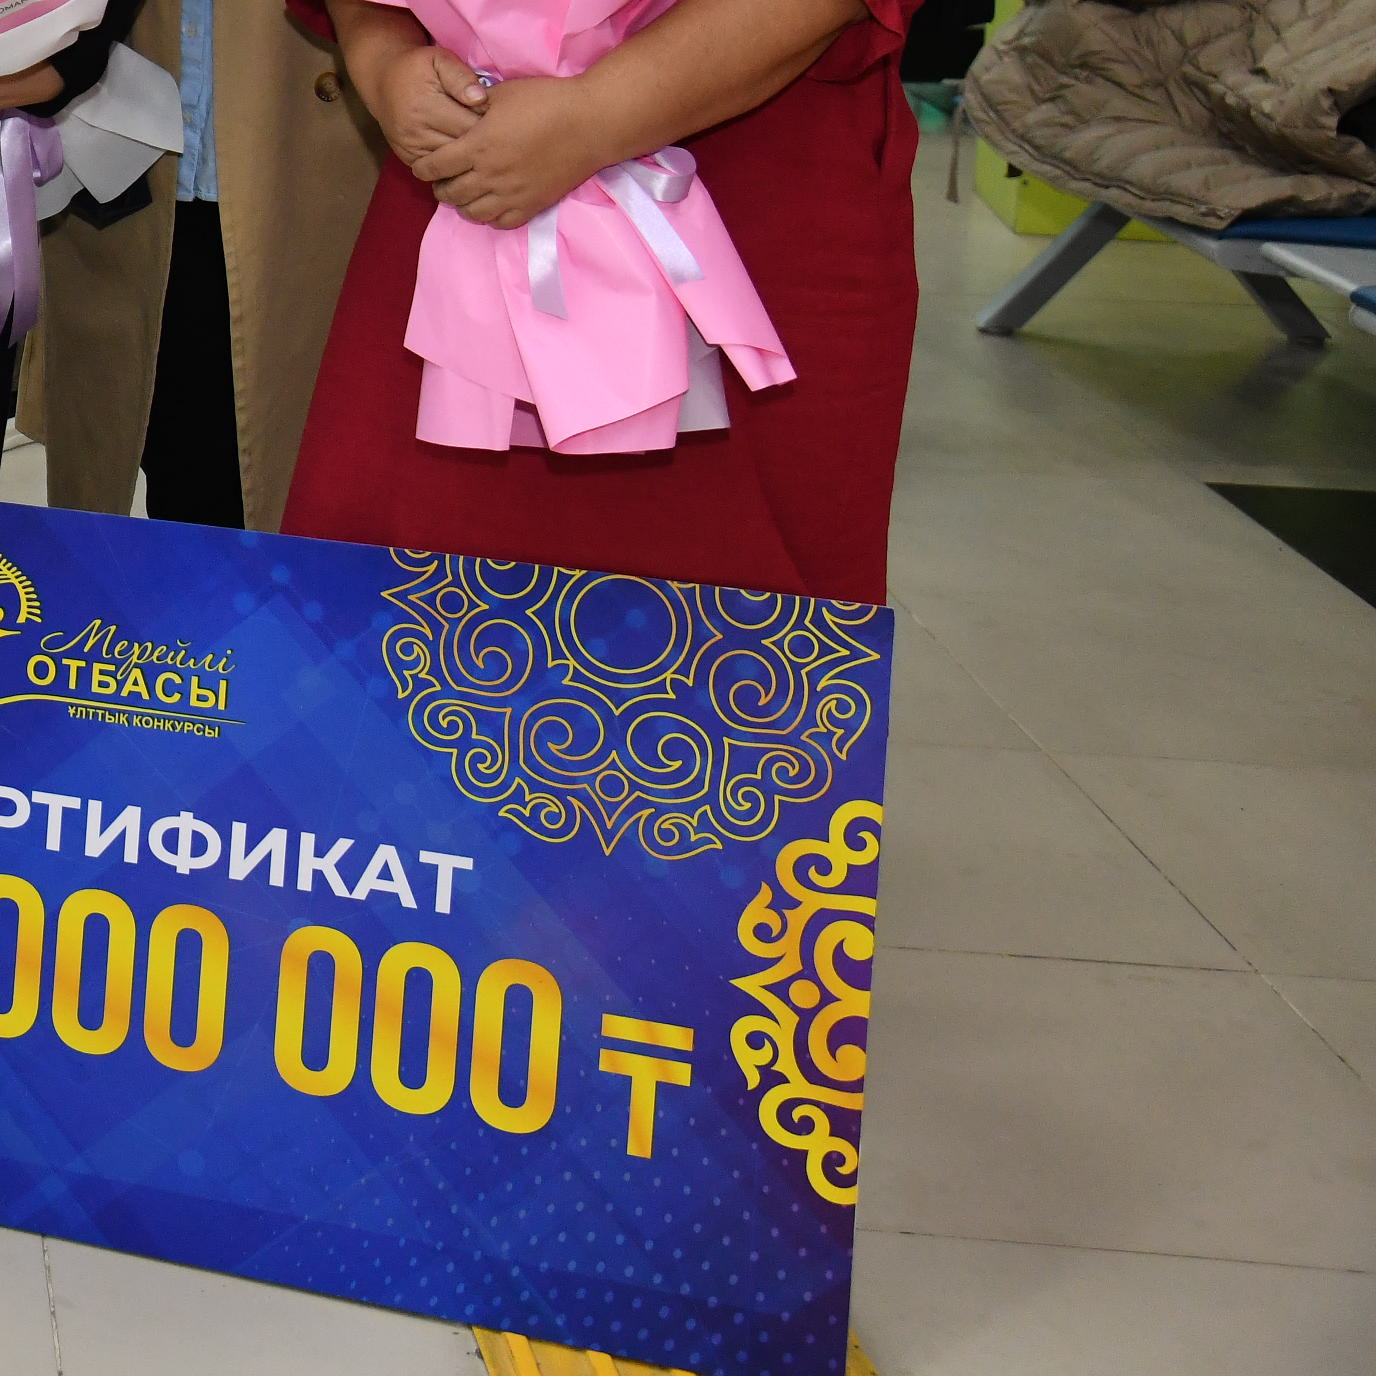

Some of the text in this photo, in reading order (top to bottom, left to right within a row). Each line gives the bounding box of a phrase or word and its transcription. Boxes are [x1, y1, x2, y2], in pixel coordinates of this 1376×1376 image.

[40, 619, 236, 680] Мерейлі
[26, 654, 229, 711] ОТБАСЫ
[68, 705, 220, 739] ҰЛТТЫҚ КОНКУРСЫ
[272, 925, 563, 1135] 000
